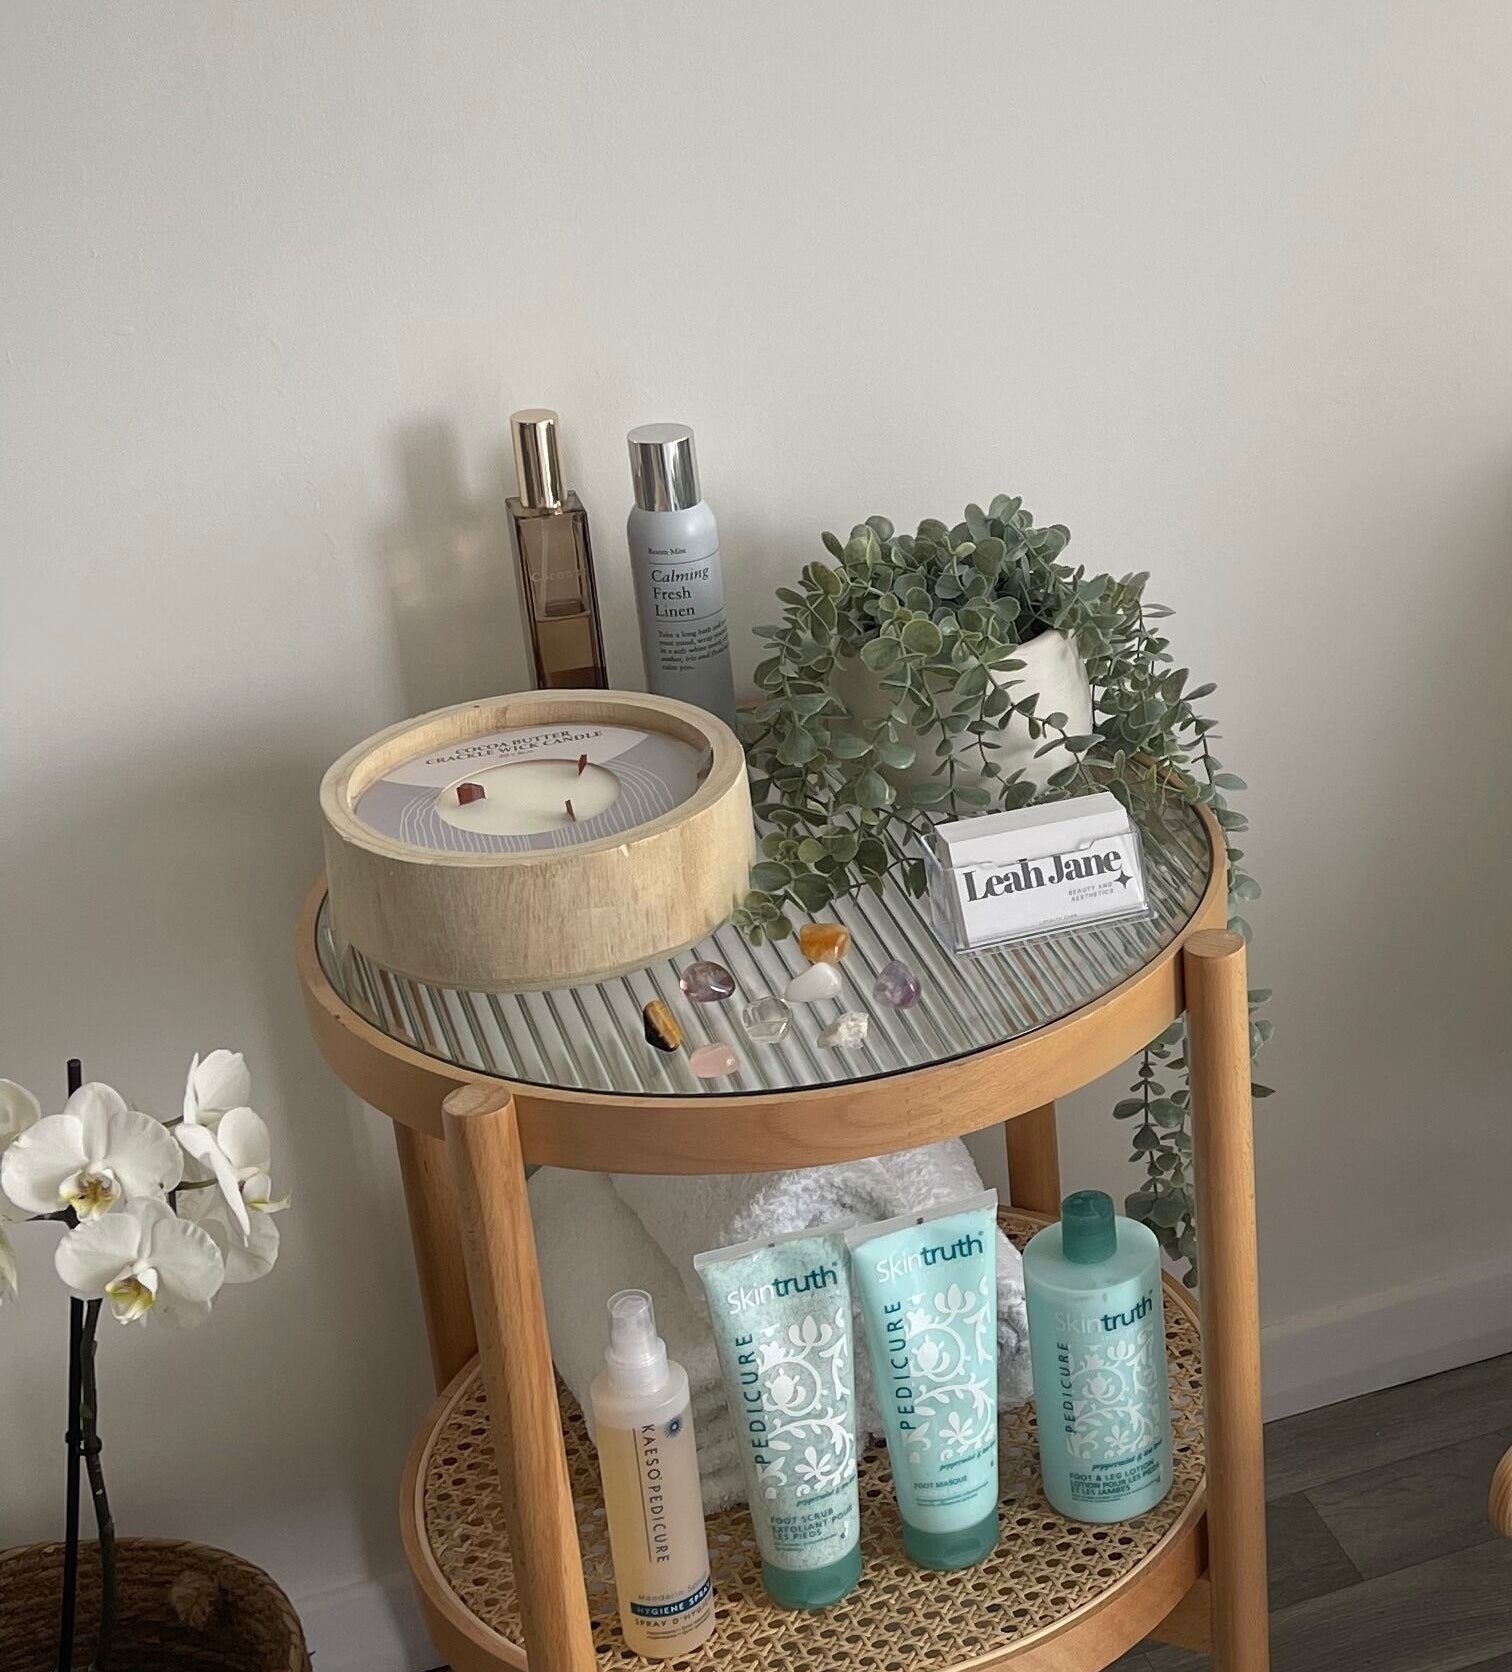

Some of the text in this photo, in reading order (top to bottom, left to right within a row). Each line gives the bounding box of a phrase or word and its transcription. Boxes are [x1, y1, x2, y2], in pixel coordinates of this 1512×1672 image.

[651, 567, 710, 583] Calming
[653, 586, 692, 600] Fresh
[655, 604, 695, 617] Linen
[425, 749, 494, 765] CRACKLE
[500, 743, 539, 754] WICK
[543, 731, 602, 746] CANDLE
[455, 730, 571, 754] COCOA BUTTER
[962, 850, 1122, 902] Leah Jane
[1068, 881, 1112, 896] BEAUTY AND
[1071, 888, 1114, 901] AESTHETICS
[884, 1301, 917, 1430] PEDICURE
[1057, 1342, 1077, 1435] PEDICURE
[735, 1333, 772, 1465] PEDICURE
[1069, 1471, 1091, 1480] FOOT
[1105, 1472, 1122, 1480] LEG
[1125, 1459, 1154, 1477] LOTION
[936, 1475, 968, 1488] MASQUE
[1103, 1478, 1126, 1489] POUR
[1128, 1475, 1142, 1484] LES
[641, 1423, 670, 1563] KAESO PEDICURE
[770, 1507, 834, 1525] FOOT SCRUB
[636, 1602, 685, 1616] HYGIENE
[634, 1617, 667, 1628] SPRAY
